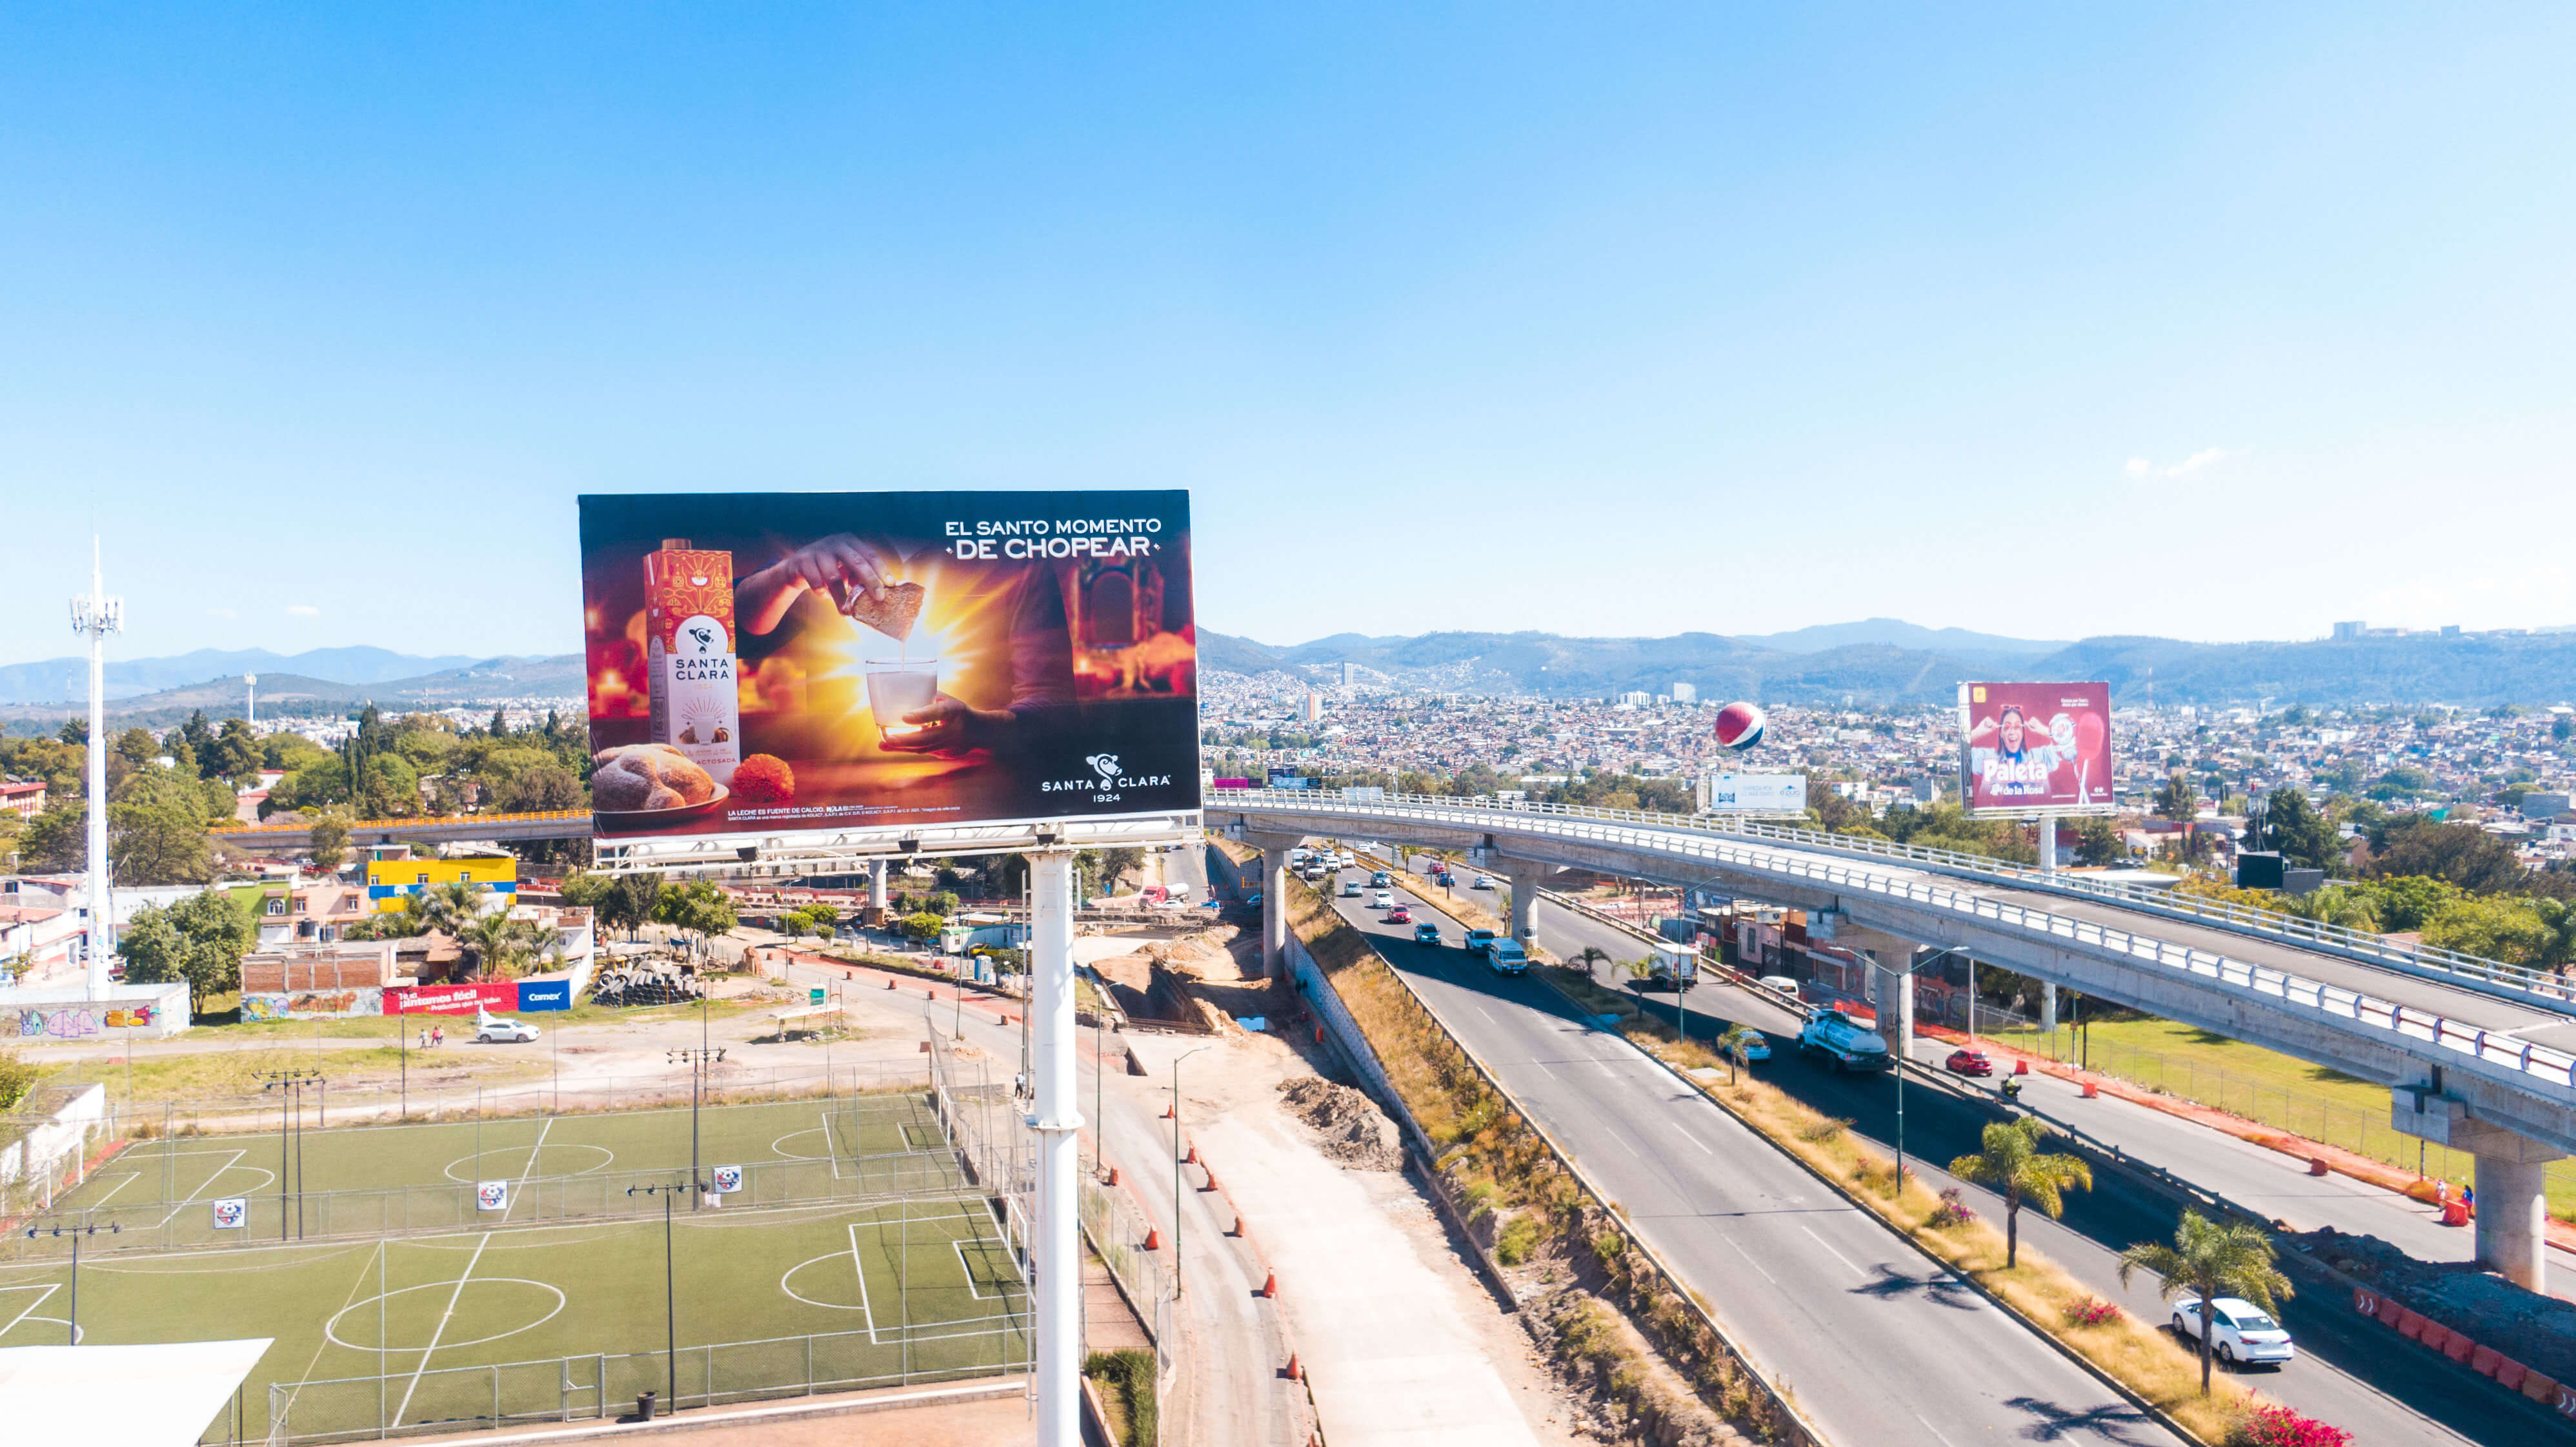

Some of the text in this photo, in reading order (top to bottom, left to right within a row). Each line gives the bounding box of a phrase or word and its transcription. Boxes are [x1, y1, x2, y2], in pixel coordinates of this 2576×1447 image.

[945, 518, 1162, 536] EL SANTO MOMENTO
[956, 536, 1150, 560] DE CHOPEAR
[676, 659, 729, 669] SANTA
[676, 671, 729, 680] CLARA
[1984, 758, 2047, 782] Paleta
[1041, 776, 1170, 791] SANTA CLARA
[2003, 784, 2044, 794] de la Rosa
[1093, 794, 1121, 802] 1924
[400, 989, 477, 1010] pintamos fácil
[528, 992, 563, 1002] Comex
